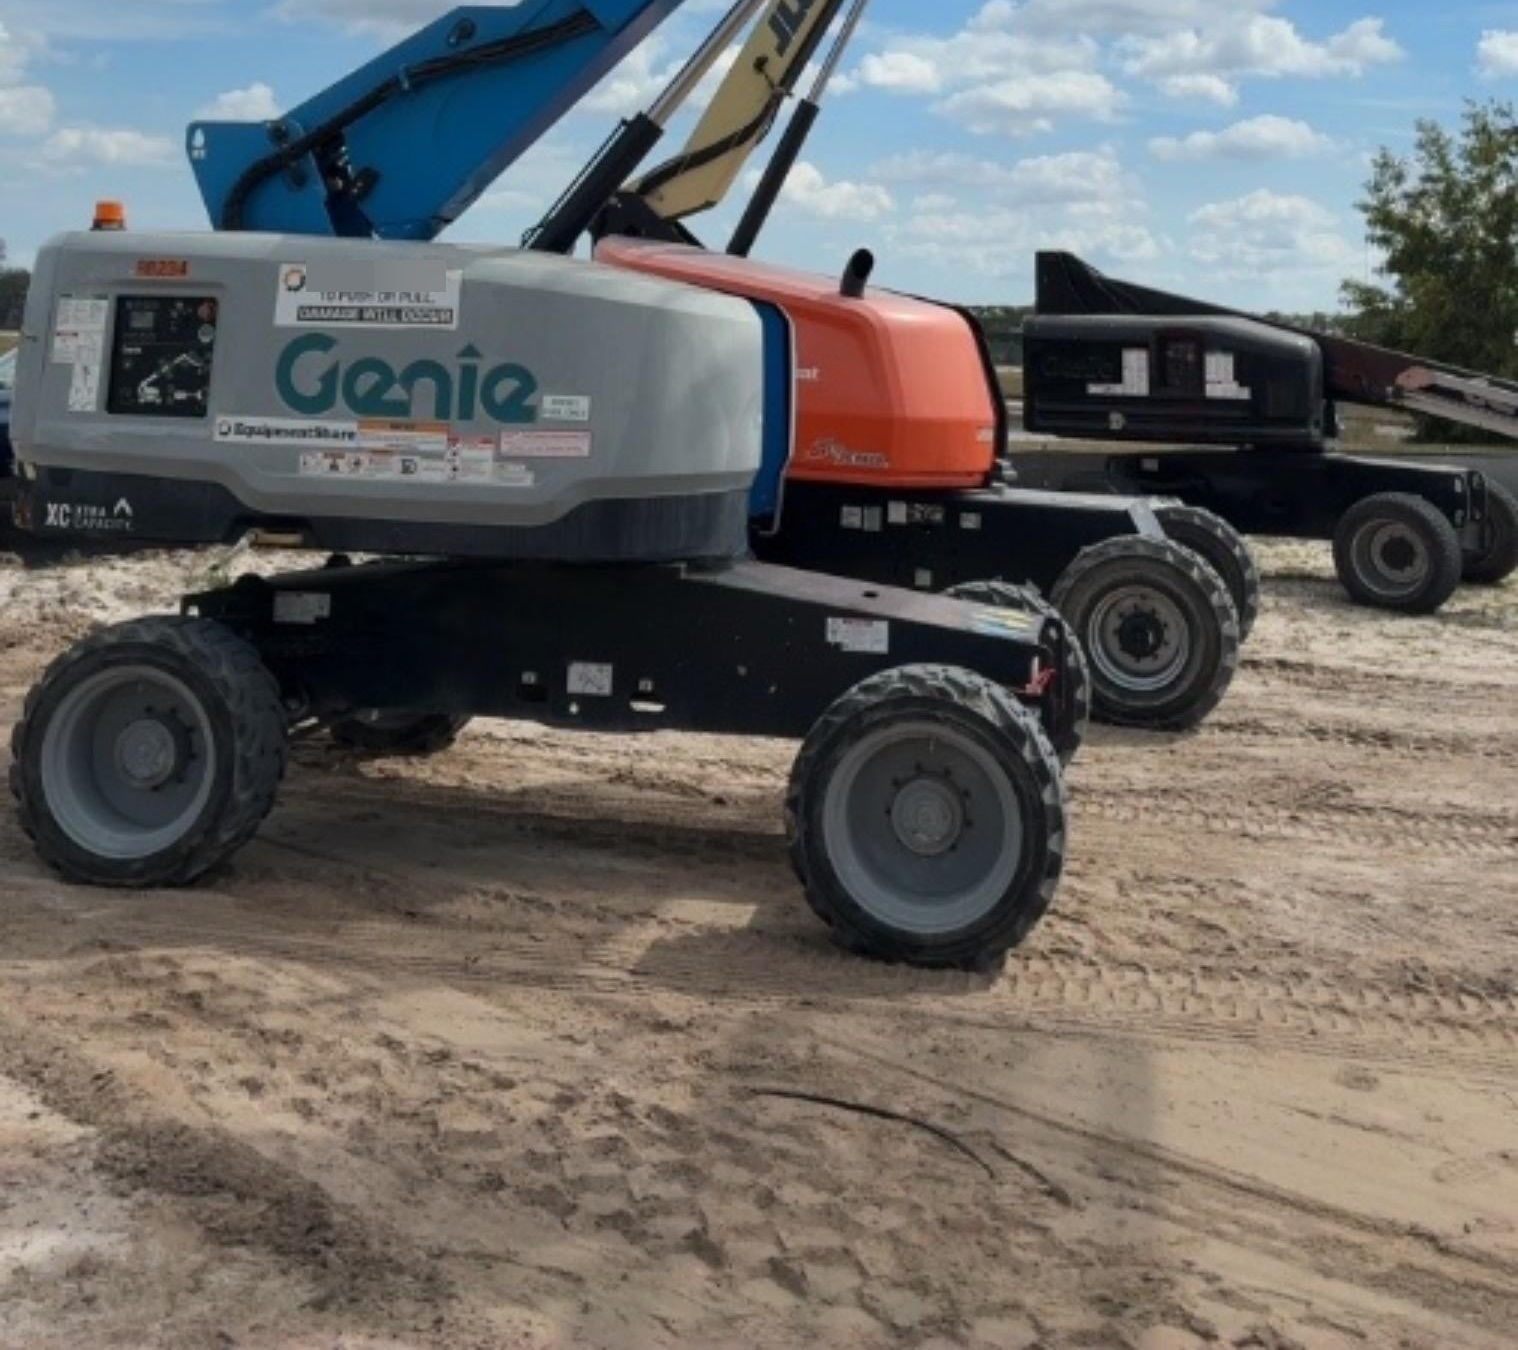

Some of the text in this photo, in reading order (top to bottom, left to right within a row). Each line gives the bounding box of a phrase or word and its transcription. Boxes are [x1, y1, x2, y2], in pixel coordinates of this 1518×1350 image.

[301, 308, 357, 320] DAMAGE
[275, 332, 538, 423] Genie
[233, 423, 356, 440] EquipmentShare
[45, 502, 70, 528] XC
